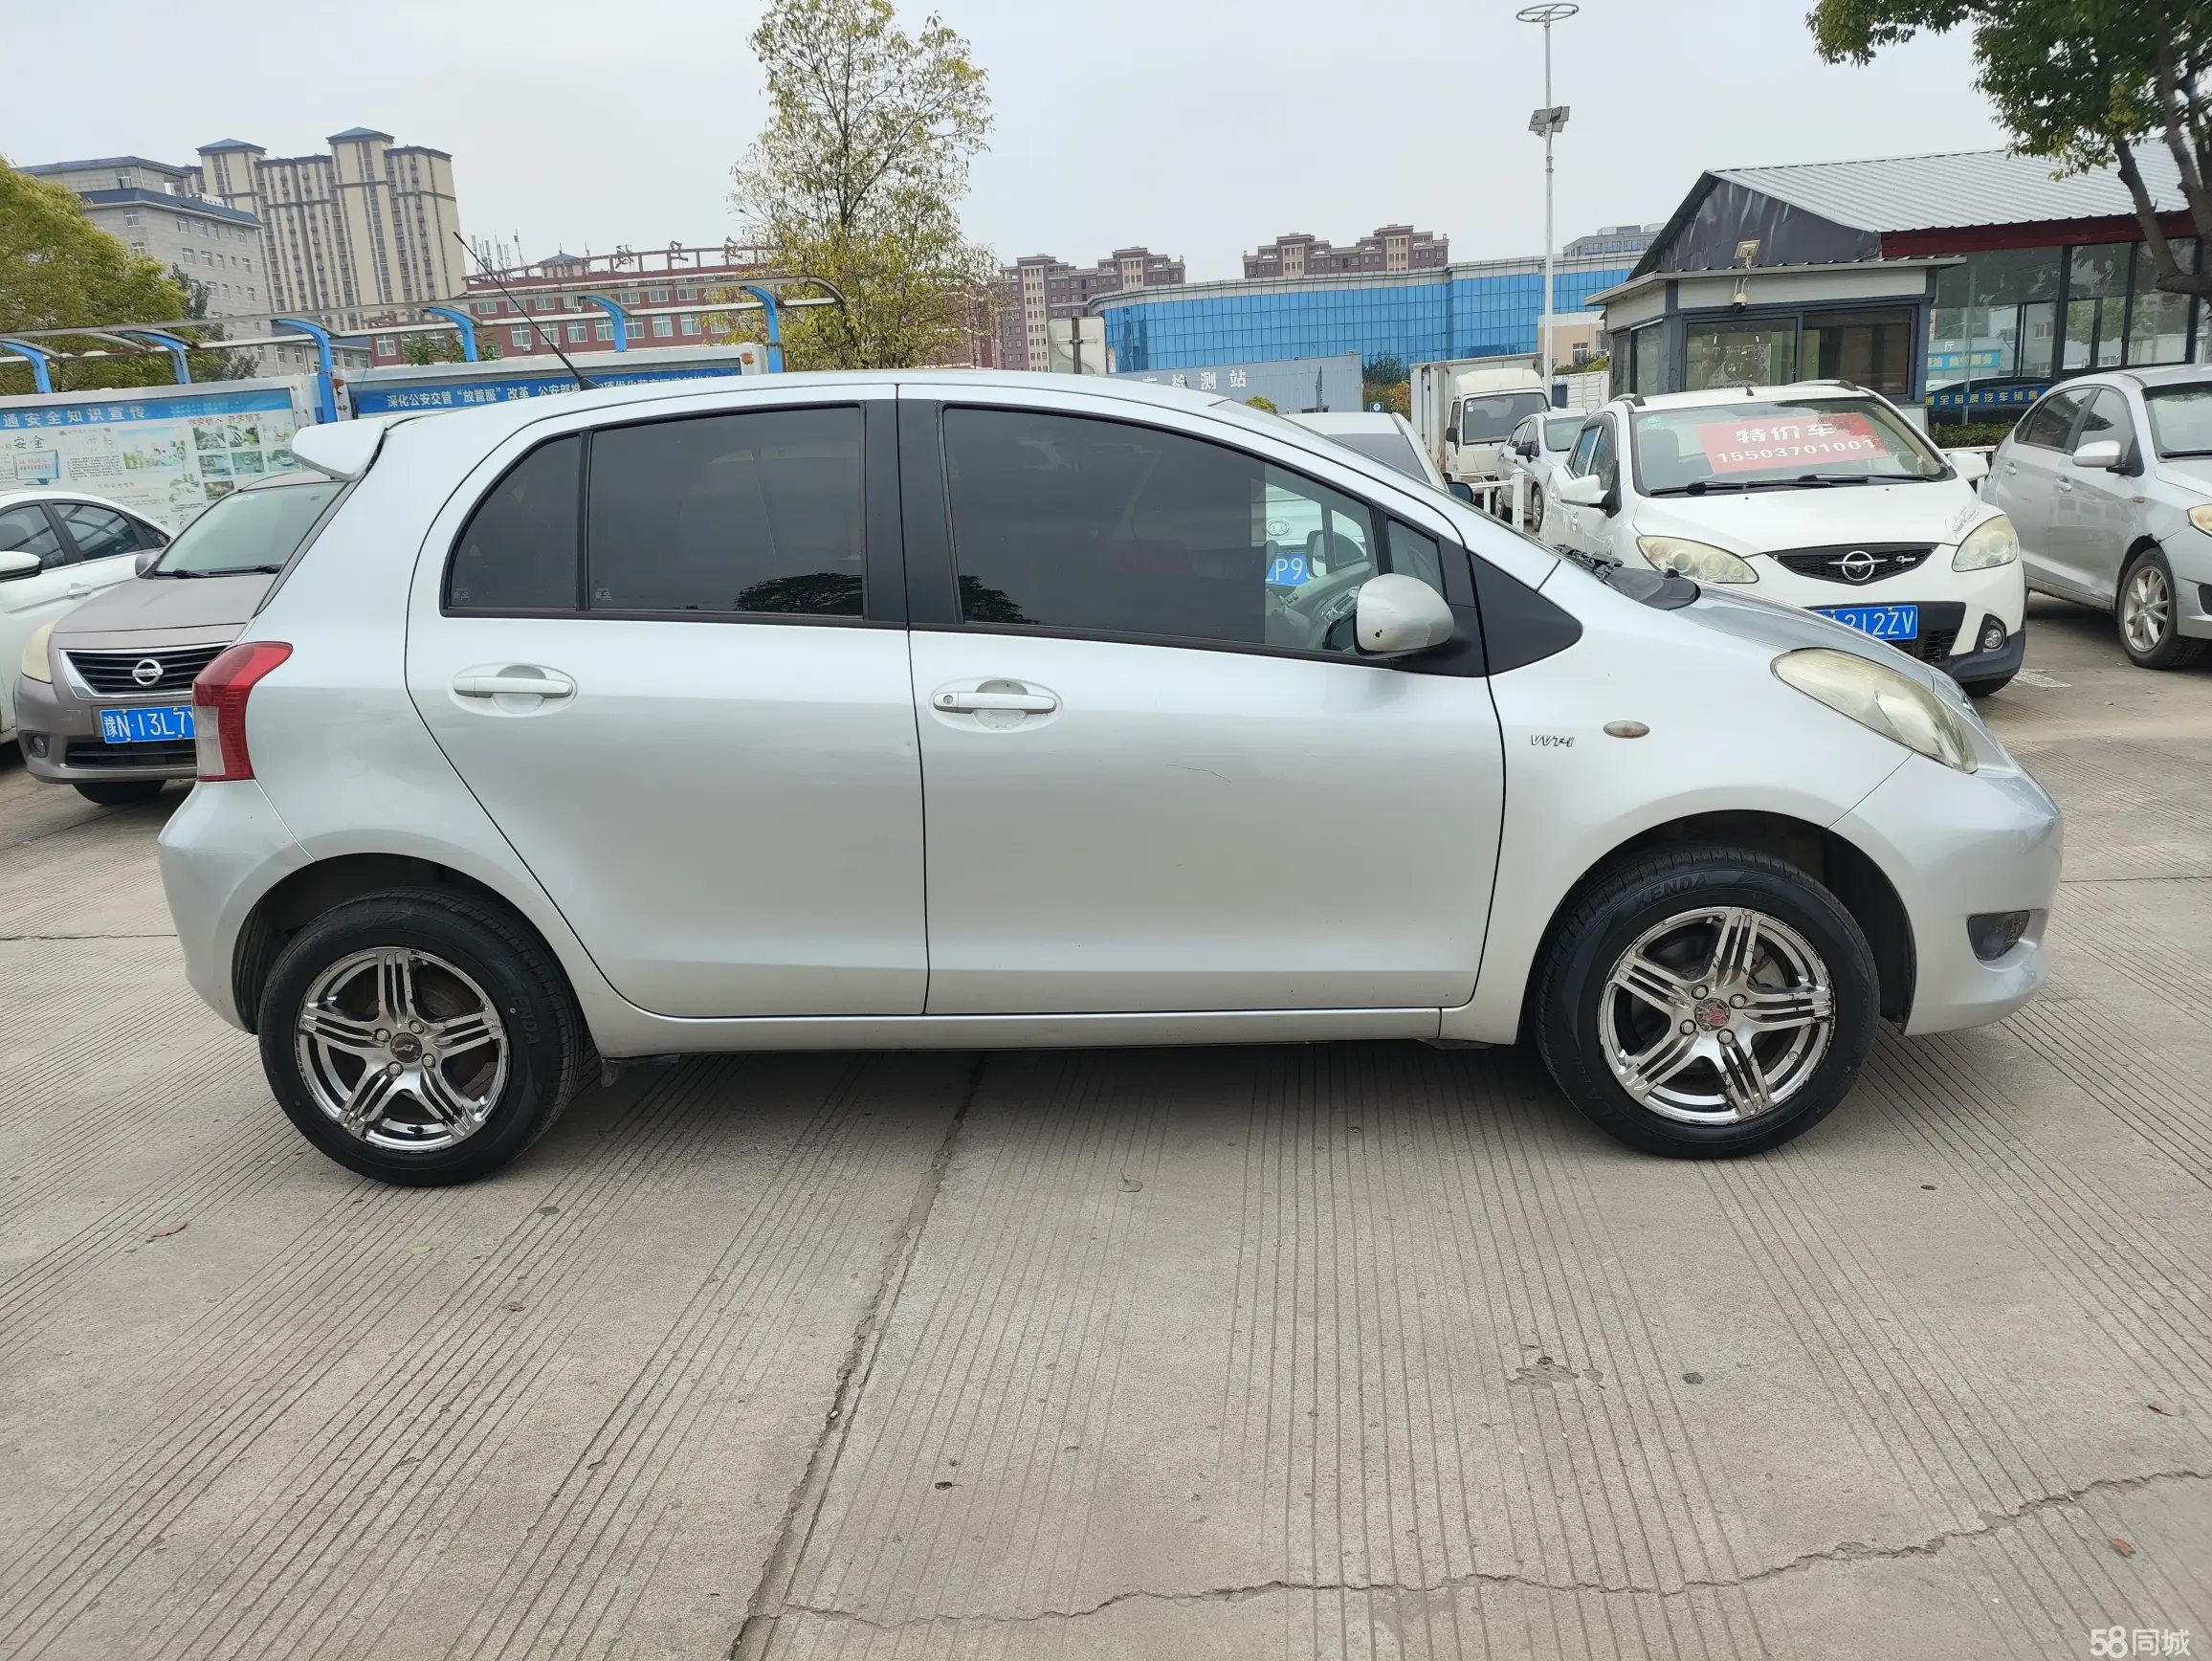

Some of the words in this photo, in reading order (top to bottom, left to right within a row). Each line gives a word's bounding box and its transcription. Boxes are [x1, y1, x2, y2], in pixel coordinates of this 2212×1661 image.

[3, 405, 145, 428] 通安全知识宣传
[1736, 423, 1835, 443] 特价车
[1717, 438, 1874, 463] 15503701001
[1833, 610, 1914, 636] 212ZV
[1635, 874, 1707, 906] KENDA
